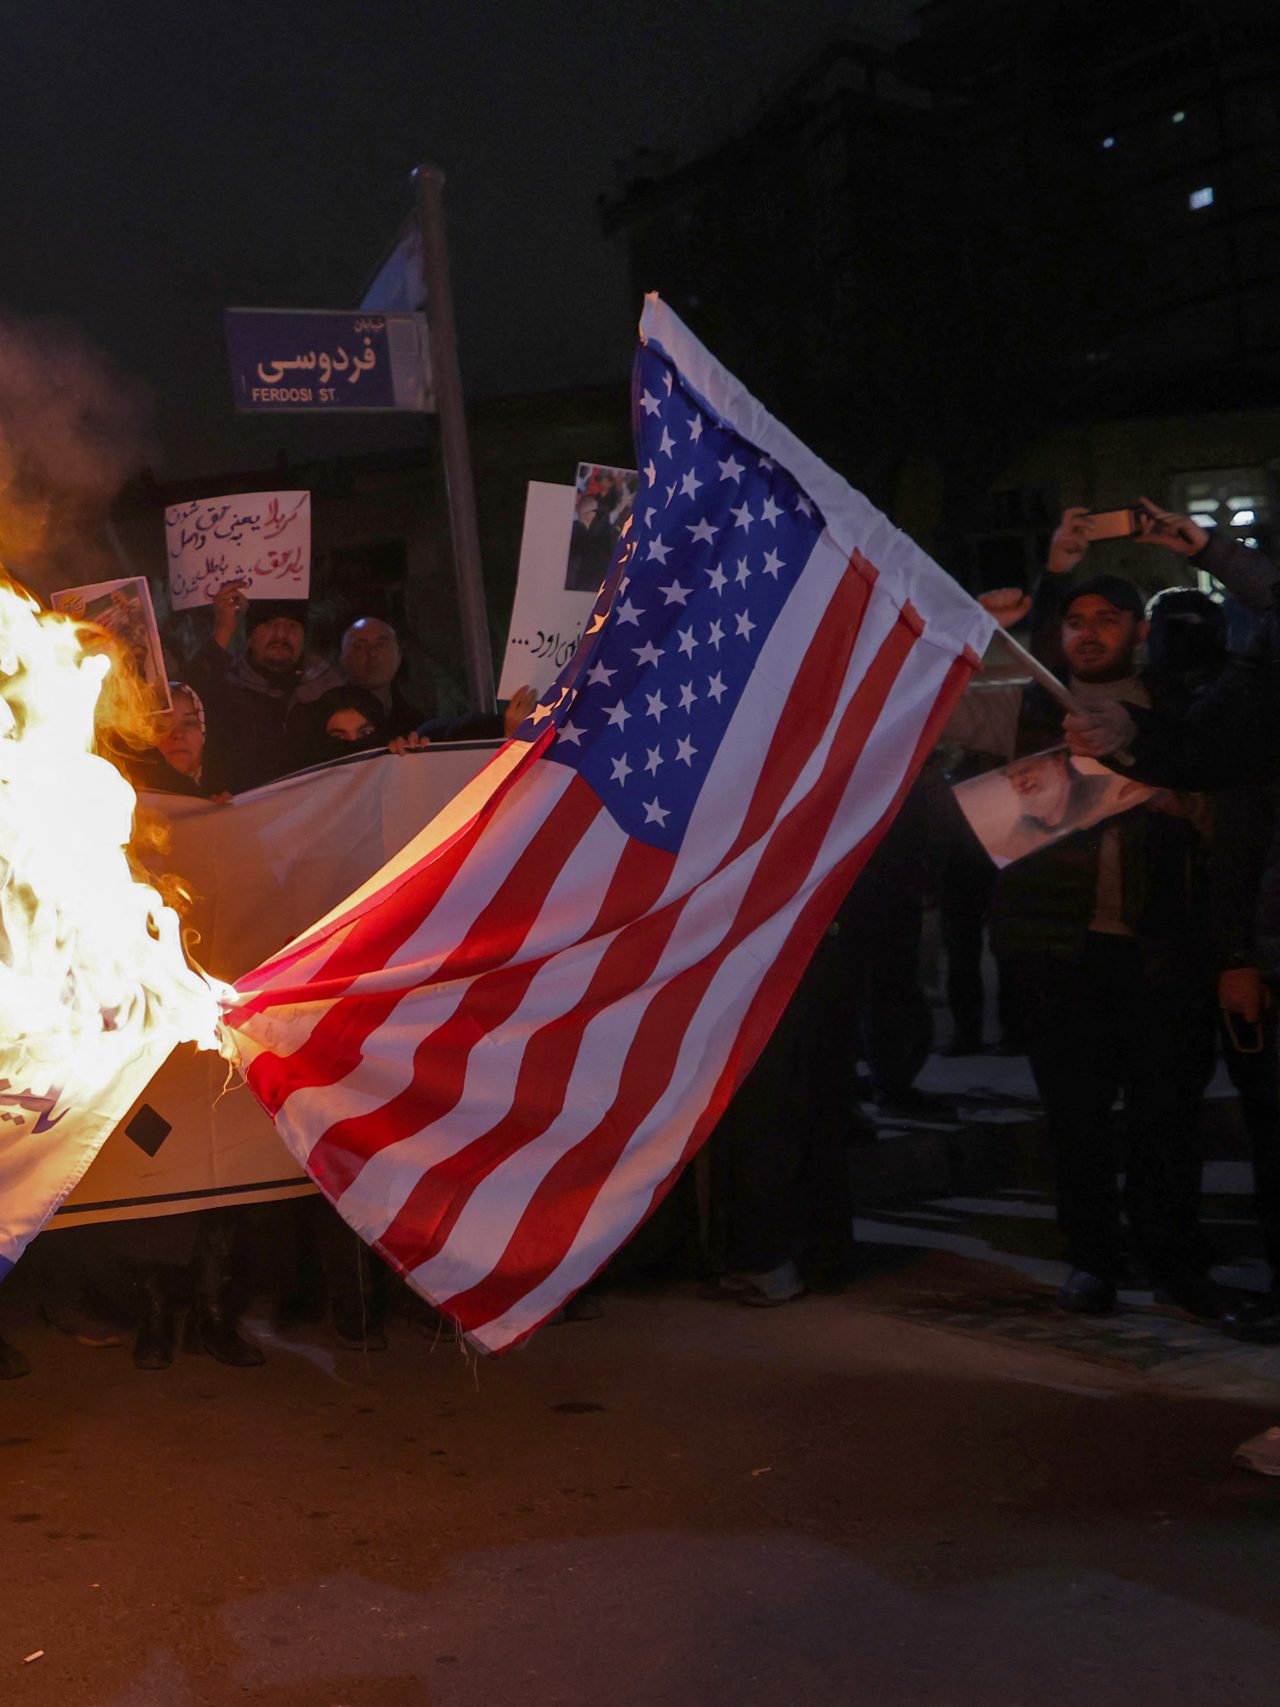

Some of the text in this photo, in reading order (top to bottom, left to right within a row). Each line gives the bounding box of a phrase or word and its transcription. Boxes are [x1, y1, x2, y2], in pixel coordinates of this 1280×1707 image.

[257, 336, 377, 384] فردوسی
[252, 388, 313, 402] FERDOSI
[263, 493, 309, 539] کربلا
